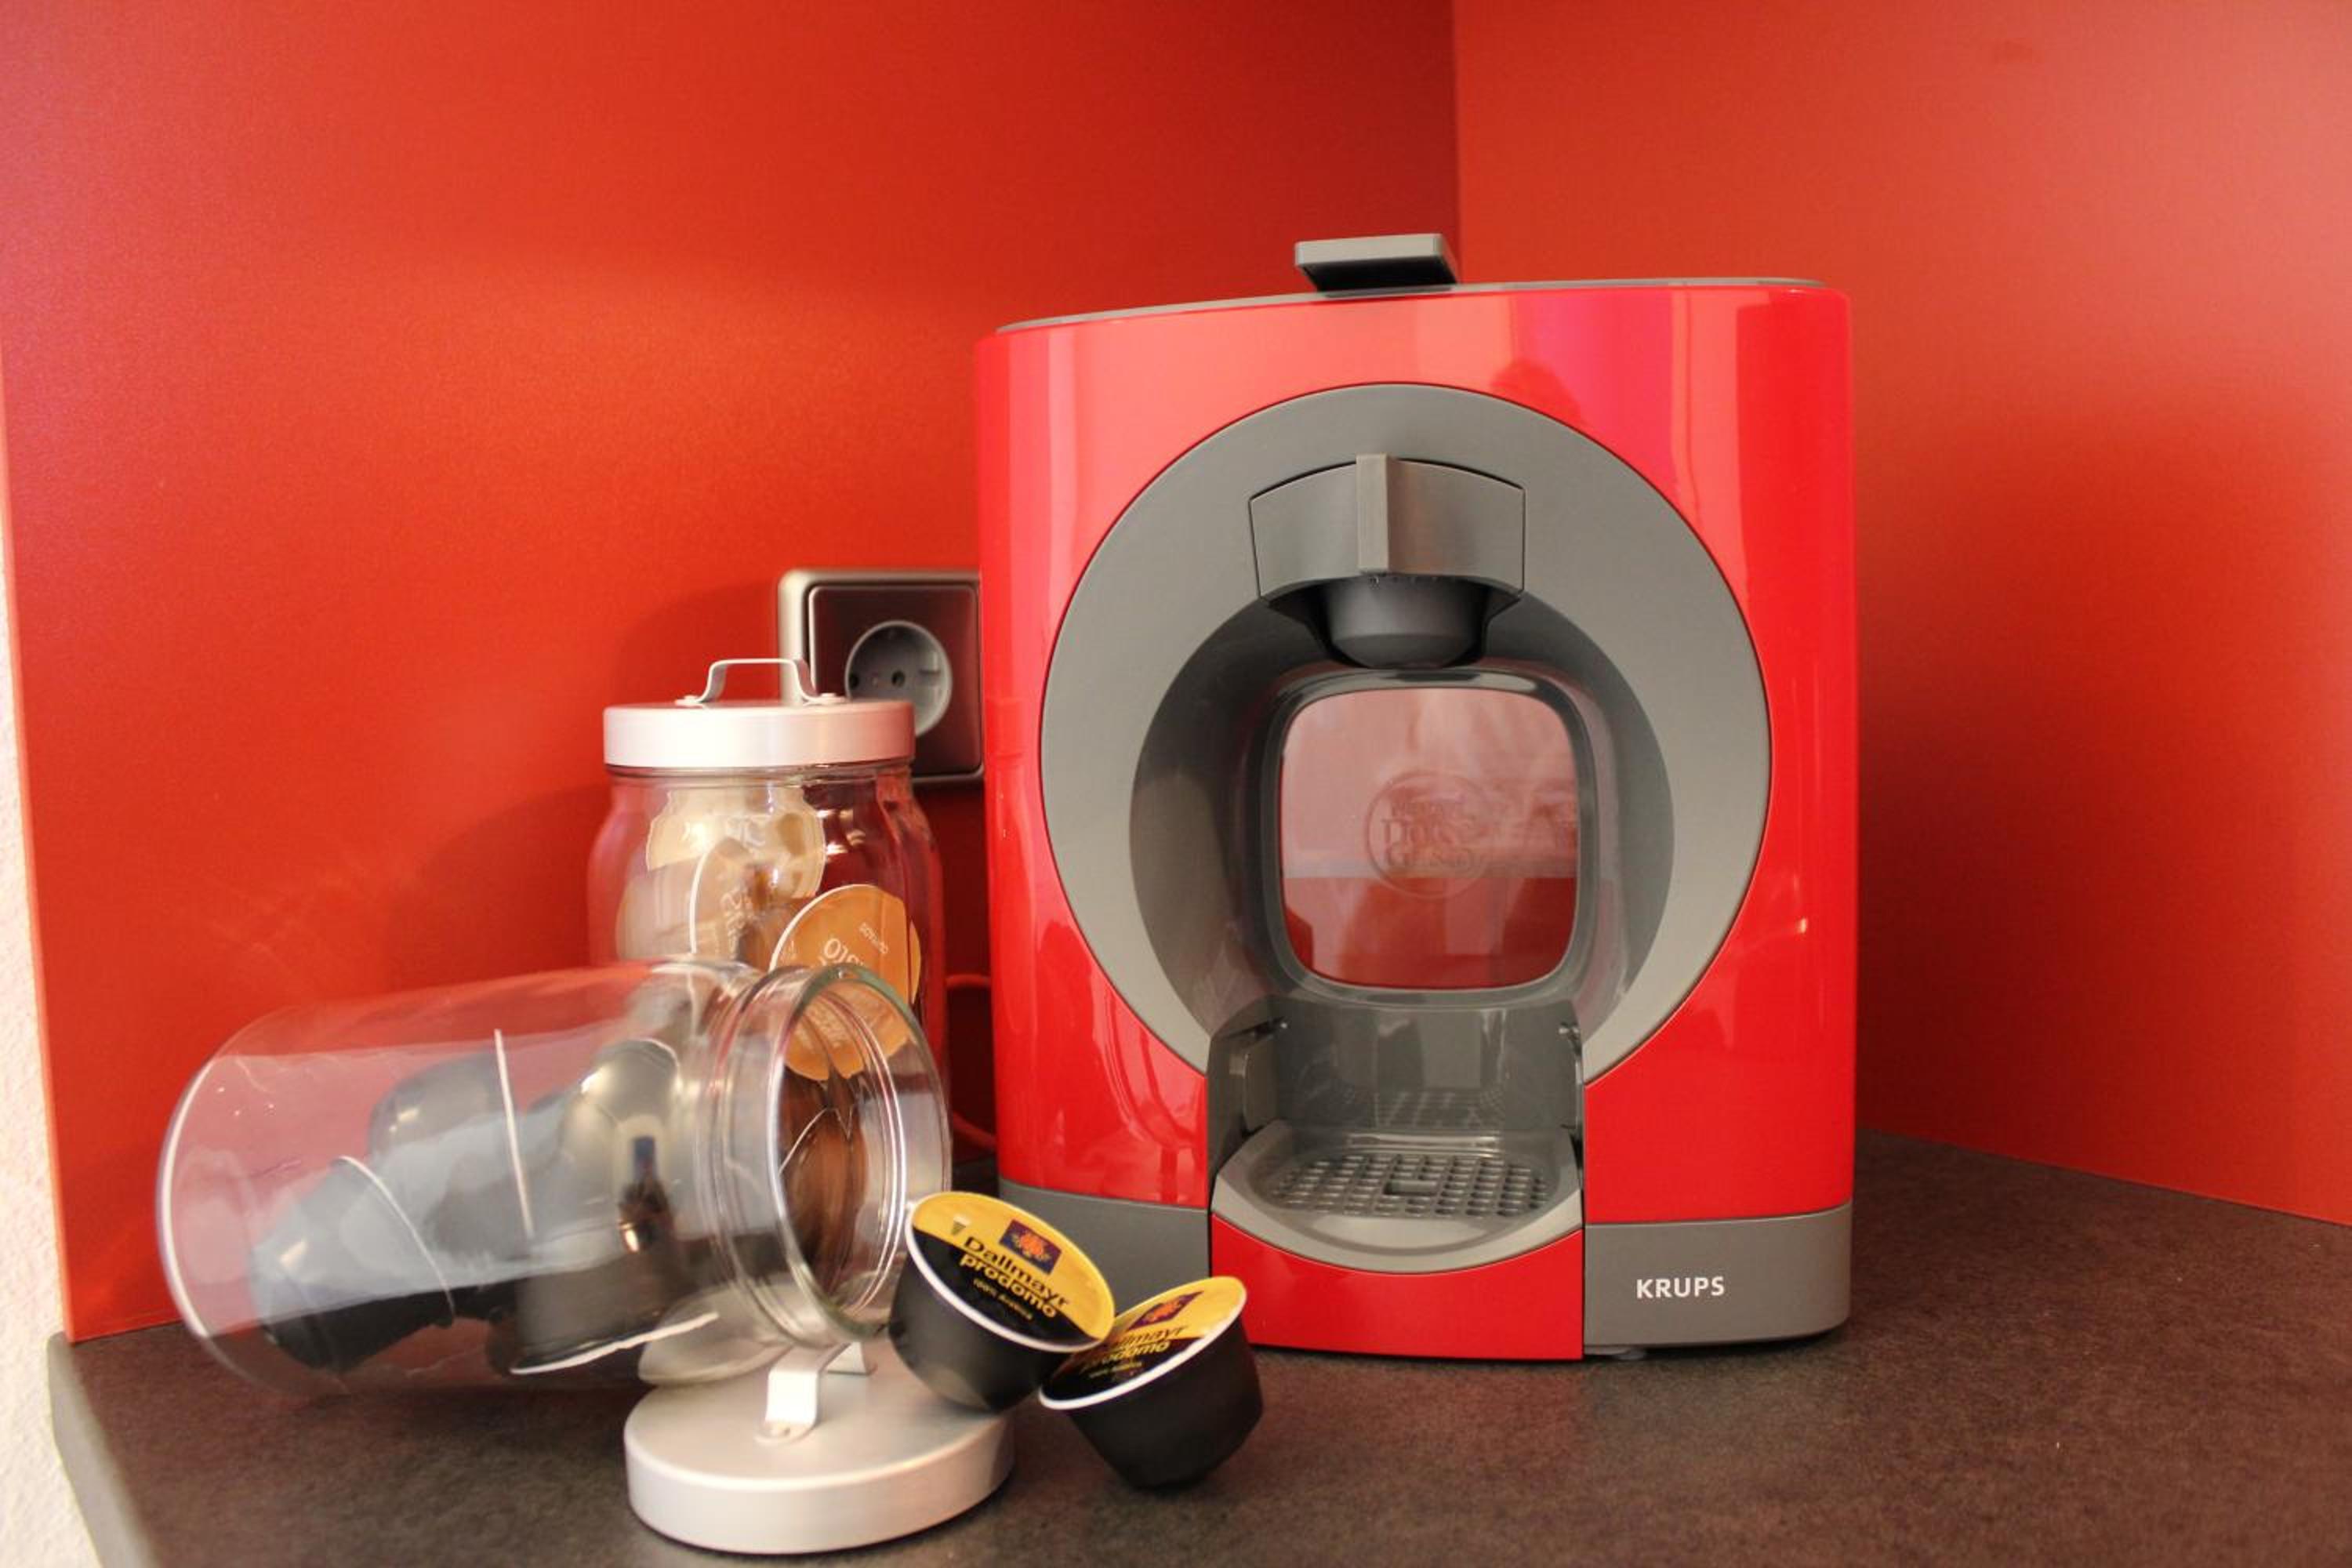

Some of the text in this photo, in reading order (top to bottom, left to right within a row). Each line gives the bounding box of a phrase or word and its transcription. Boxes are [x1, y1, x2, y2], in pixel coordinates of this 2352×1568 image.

[959, 1254, 1057, 1318] prodomo
[964, 1236, 1068, 1305] Dallmayr
[1636, 1276, 1725, 1298] KRUPS
